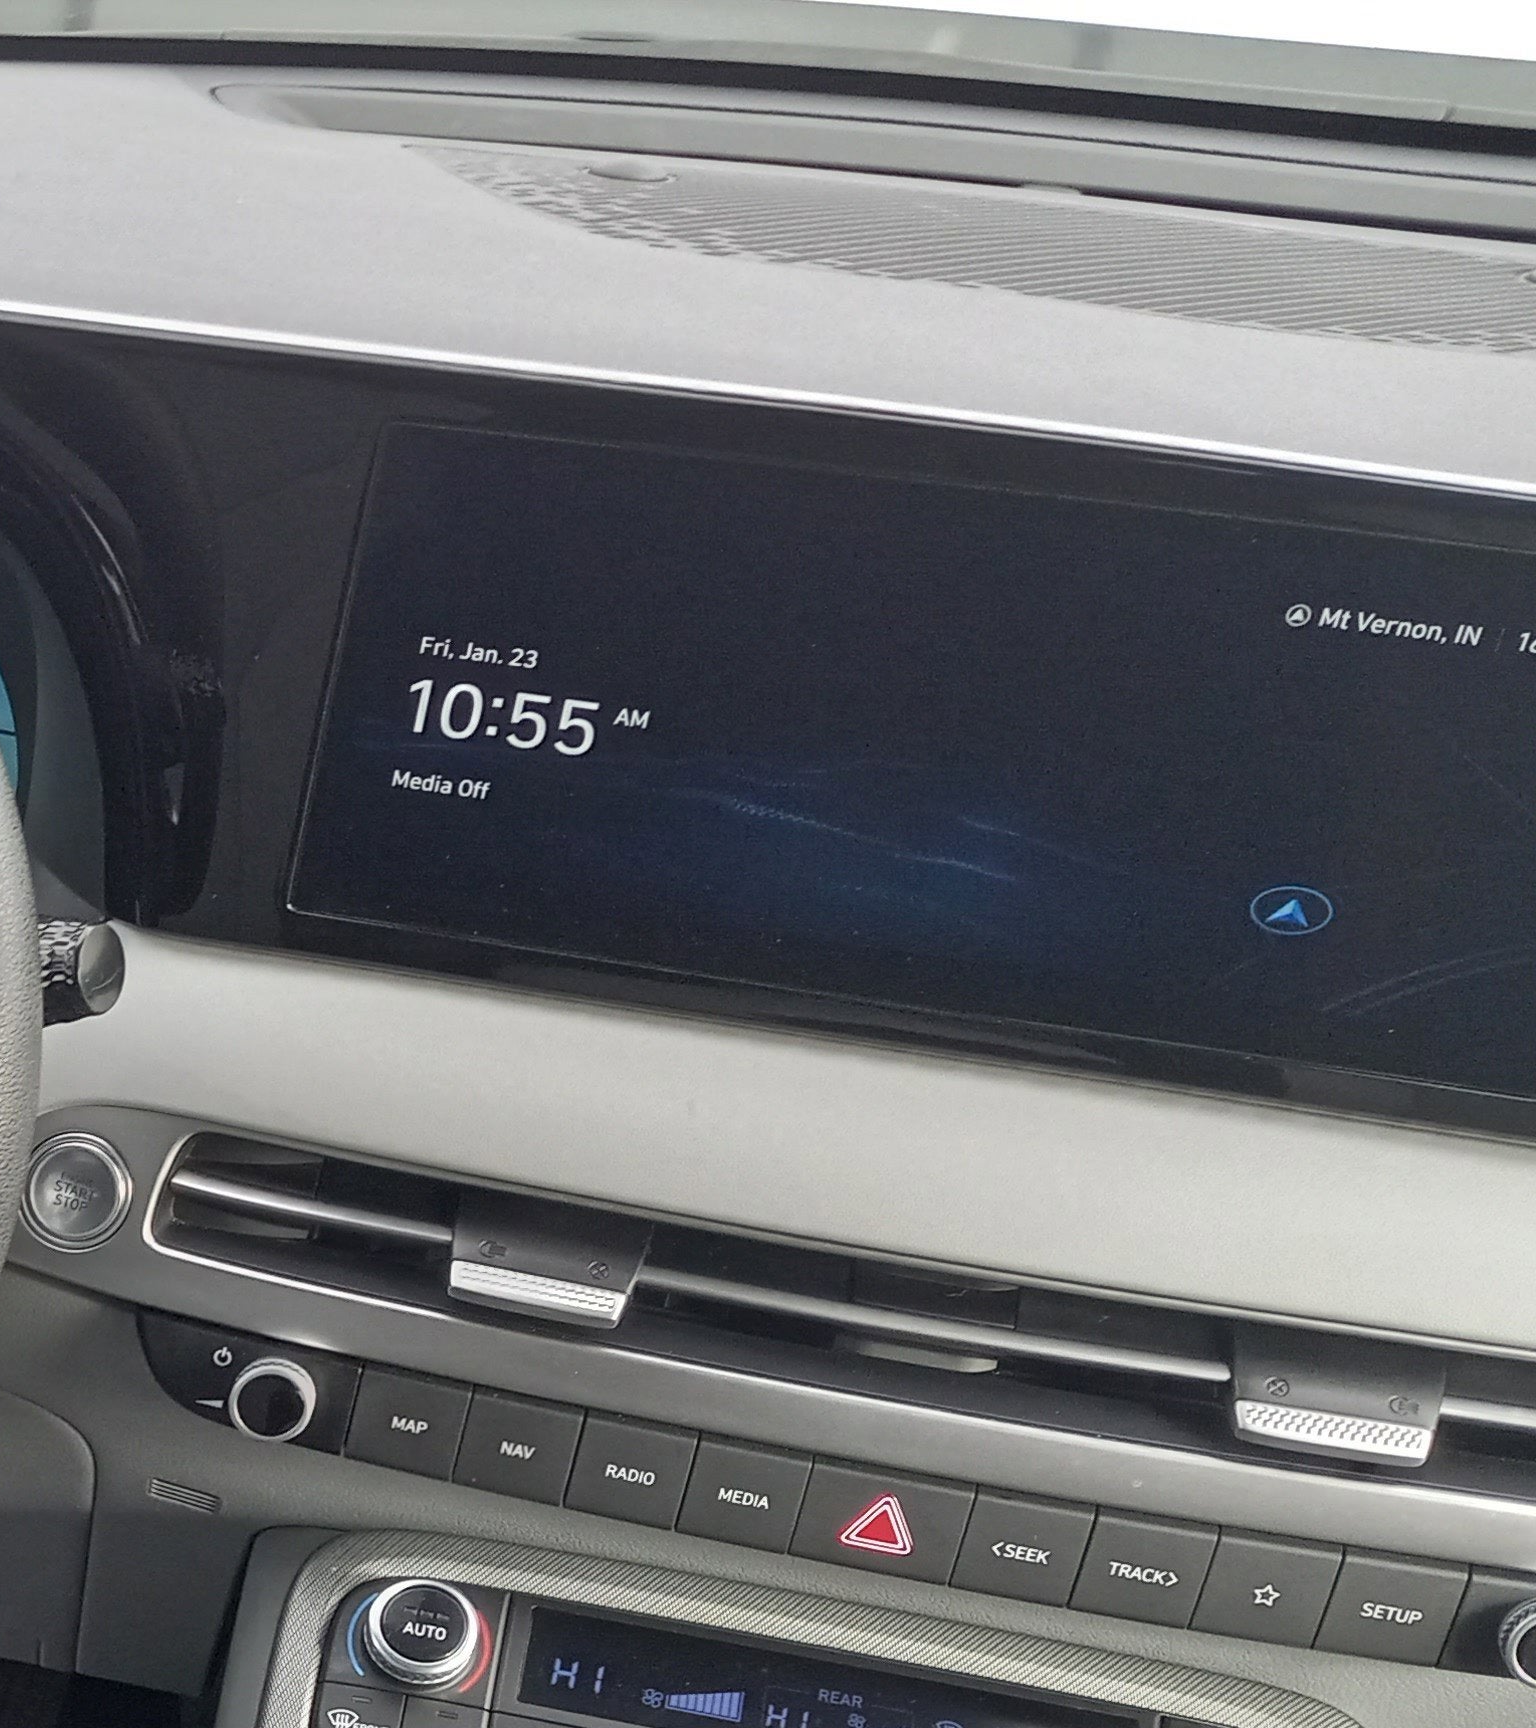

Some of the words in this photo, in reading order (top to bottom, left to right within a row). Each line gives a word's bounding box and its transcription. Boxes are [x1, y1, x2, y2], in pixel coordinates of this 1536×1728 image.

[1318, 607, 1352, 630] Mt
[1357, 611, 1448, 645] Vernon,
[1454, 624, 1484, 647] IN
[418, 636, 455, 660] Fri,
[459, 642, 504, 665] Jan.
[507, 648, 540, 669] 23
[409, 679, 601, 756] 10:55
[613, 707, 651, 729] AM
[391, 769, 453, 795] Media
[457, 778, 492, 800] Off
[52, 1193, 89, 1212] STOP
[53, 1180, 96, 1202] START
[391, 1415, 429, 1435] MAP
[499, 1440, 536, 1460] NAV
[604, 1463, 656, 1487] RADIO
[718, 1487, 770, 1510] MEDIA
[1360, 1602, 1423, 1625] SETUP
[402, 1621, 448, 1642] AUTO
[817, 1688, 864, 1708] REAR
